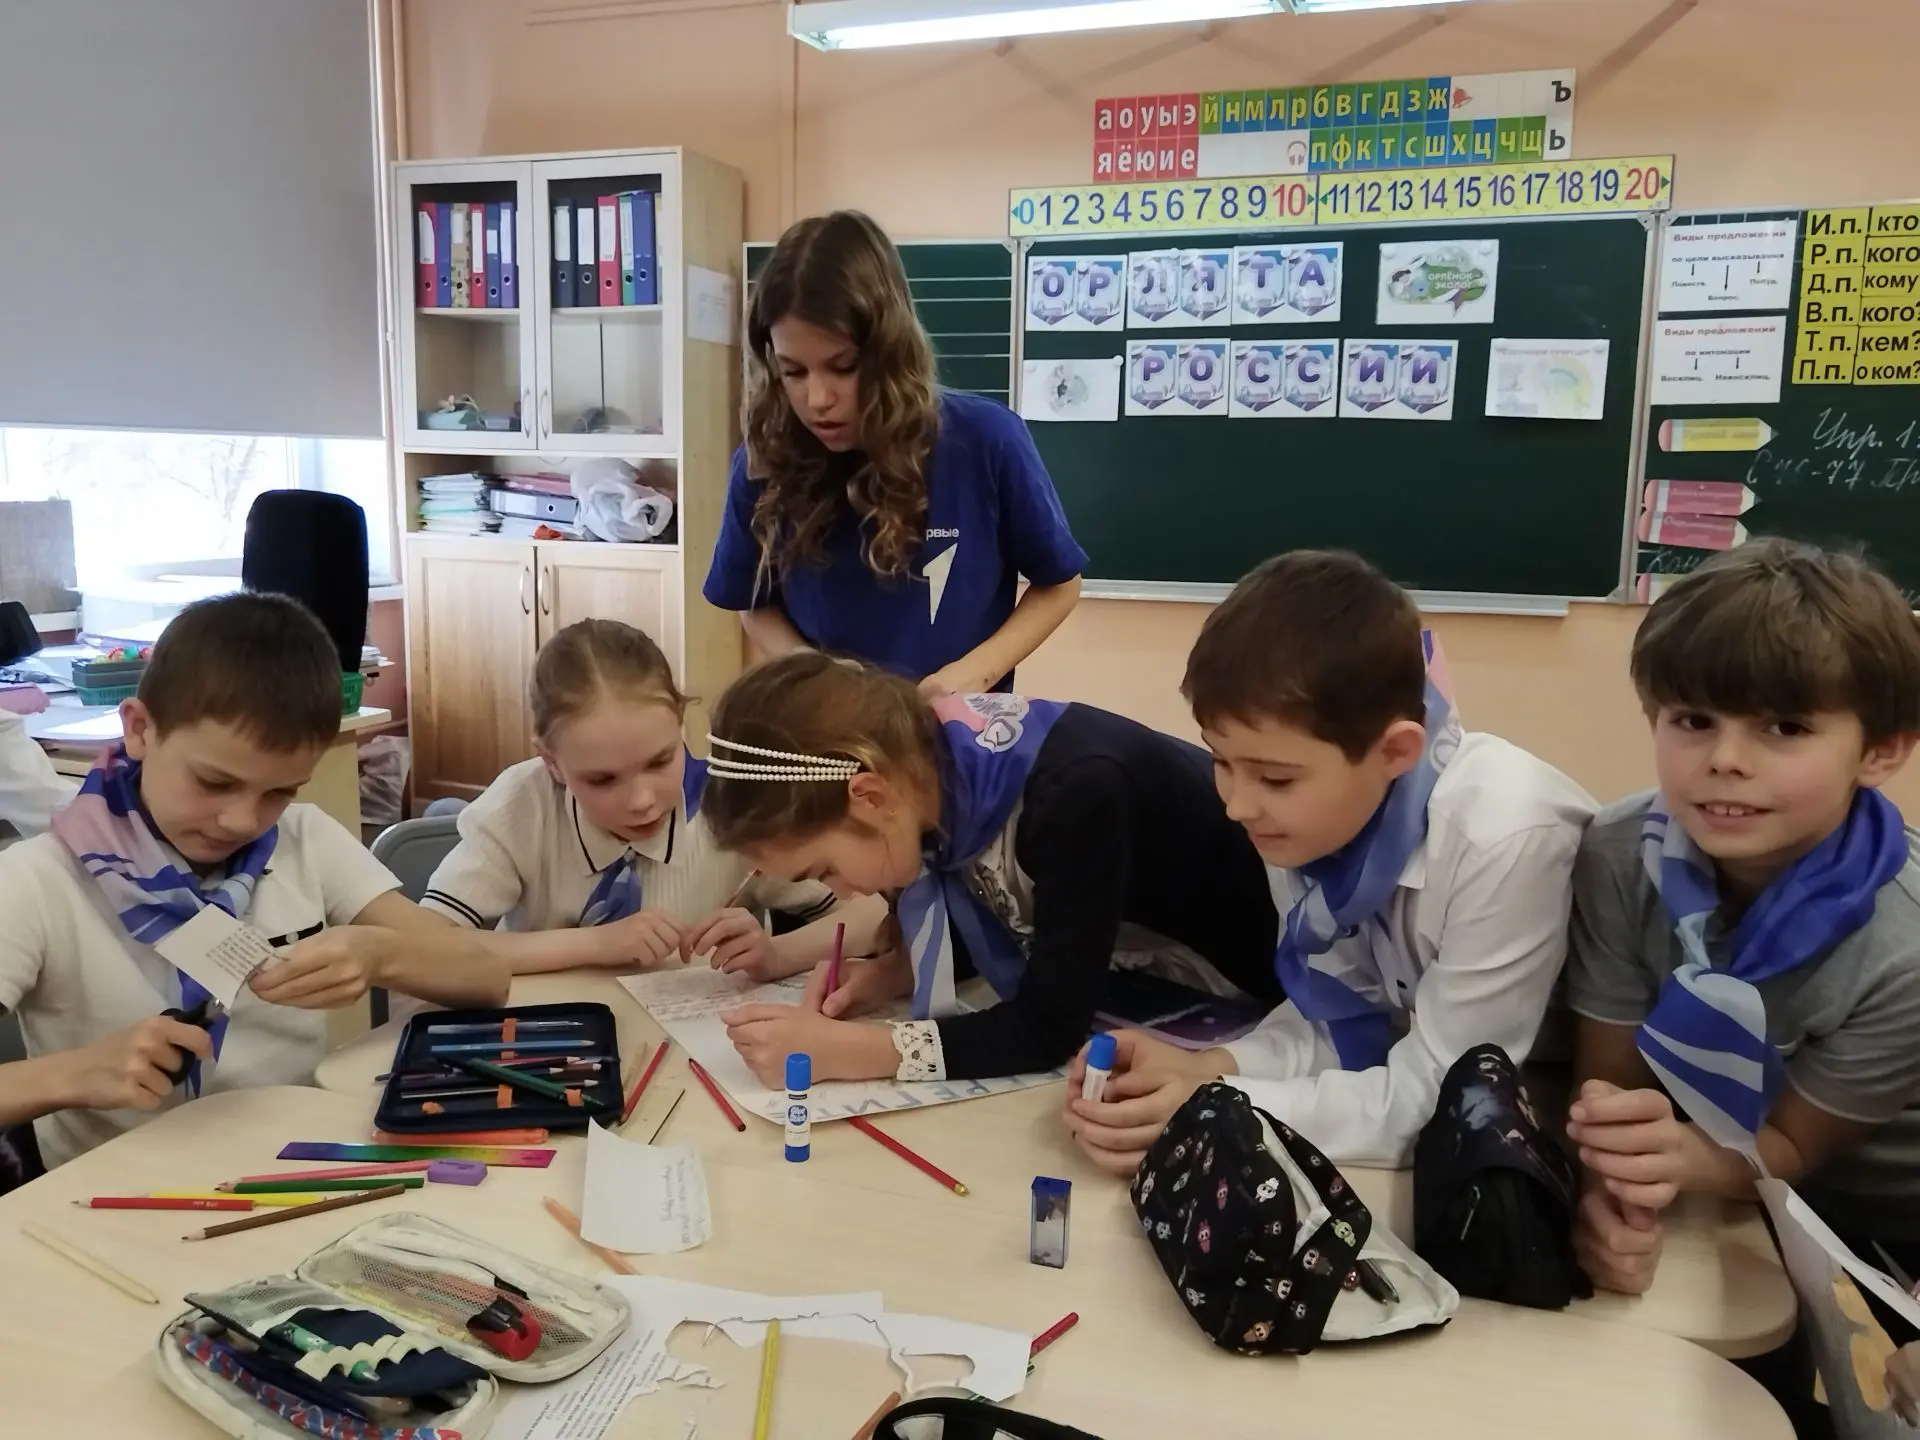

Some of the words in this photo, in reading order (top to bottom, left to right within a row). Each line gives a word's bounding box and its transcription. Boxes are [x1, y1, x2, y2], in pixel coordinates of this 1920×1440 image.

[1272, 183, 1306, 217] 10
[1328, 183, 1350, 214] 11
[1355, 182, 1382, 212] 12
[1387, 179, 1413, 211] 13
[1419, 178, 1447, 209] 14
[1454, 176, 1481, 207] 15
[1488, 174, 1515, 207] 16
[1522, 173, 1550, 205] 17
[1556, 171, 1584, 203] 18
[1590, 169, 1619, 201] 19
[1625, 166, 1660, 200] 20
[1673, 233, 1704, 242] Виды
[1664, 327, 1694, 337] Виды
[926, 528, 960, 541] рвые
